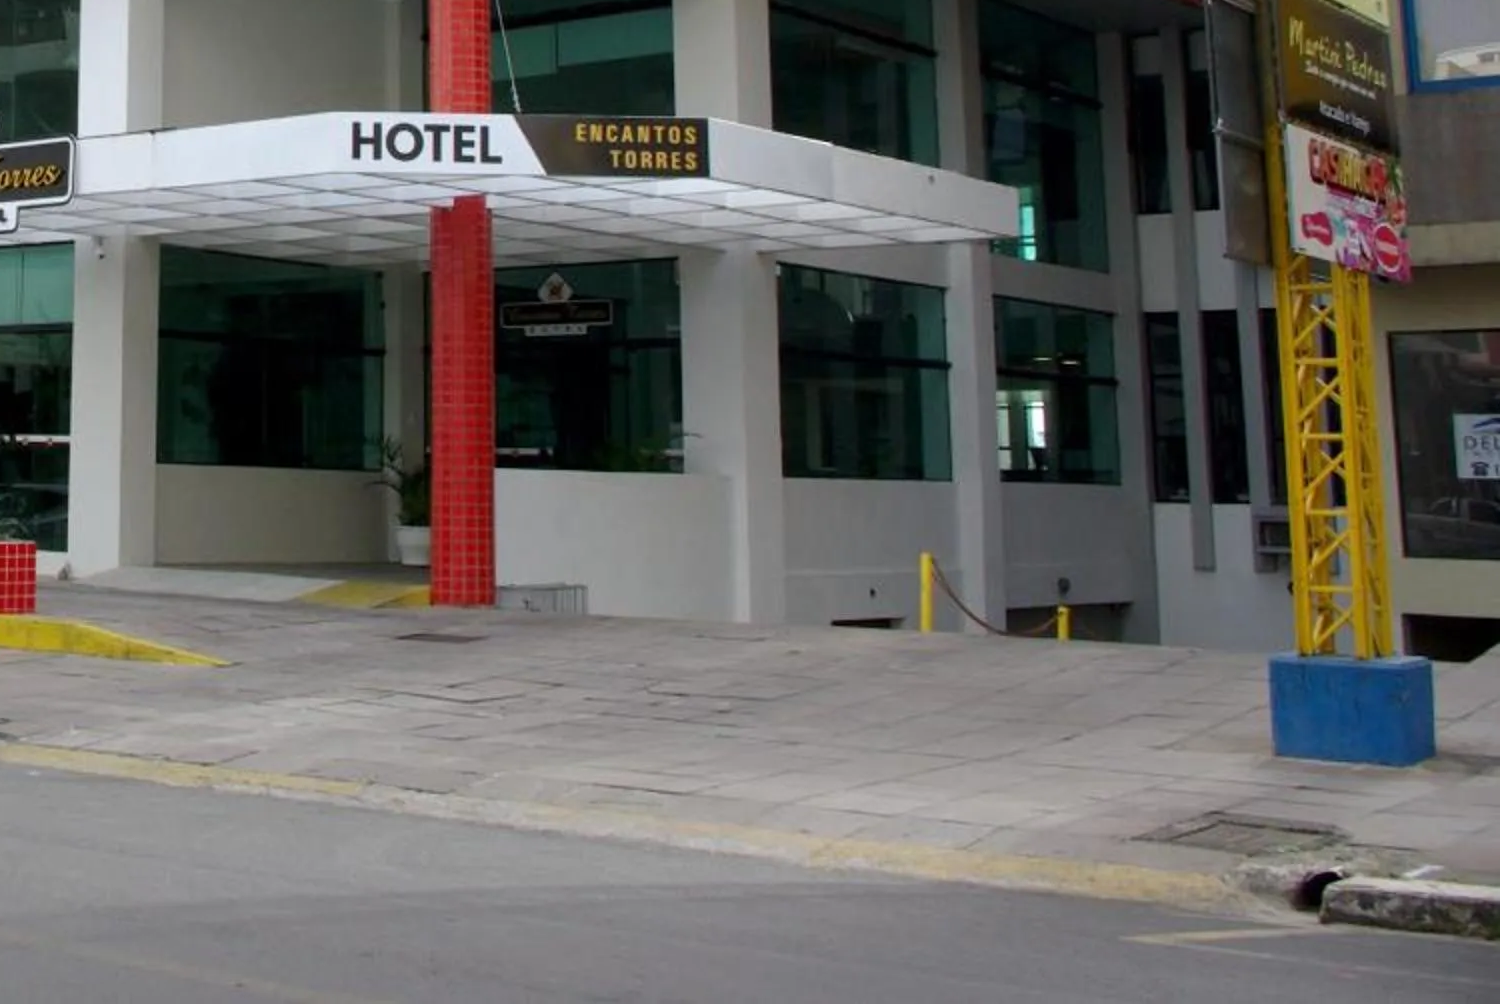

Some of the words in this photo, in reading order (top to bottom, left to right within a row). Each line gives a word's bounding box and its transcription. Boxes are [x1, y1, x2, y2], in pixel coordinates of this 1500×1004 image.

[351, 121, 503, 165] HOTEL
[574, 123, 698, 145] ENCANTOS
[609, 149, 698, 171] TORRES
